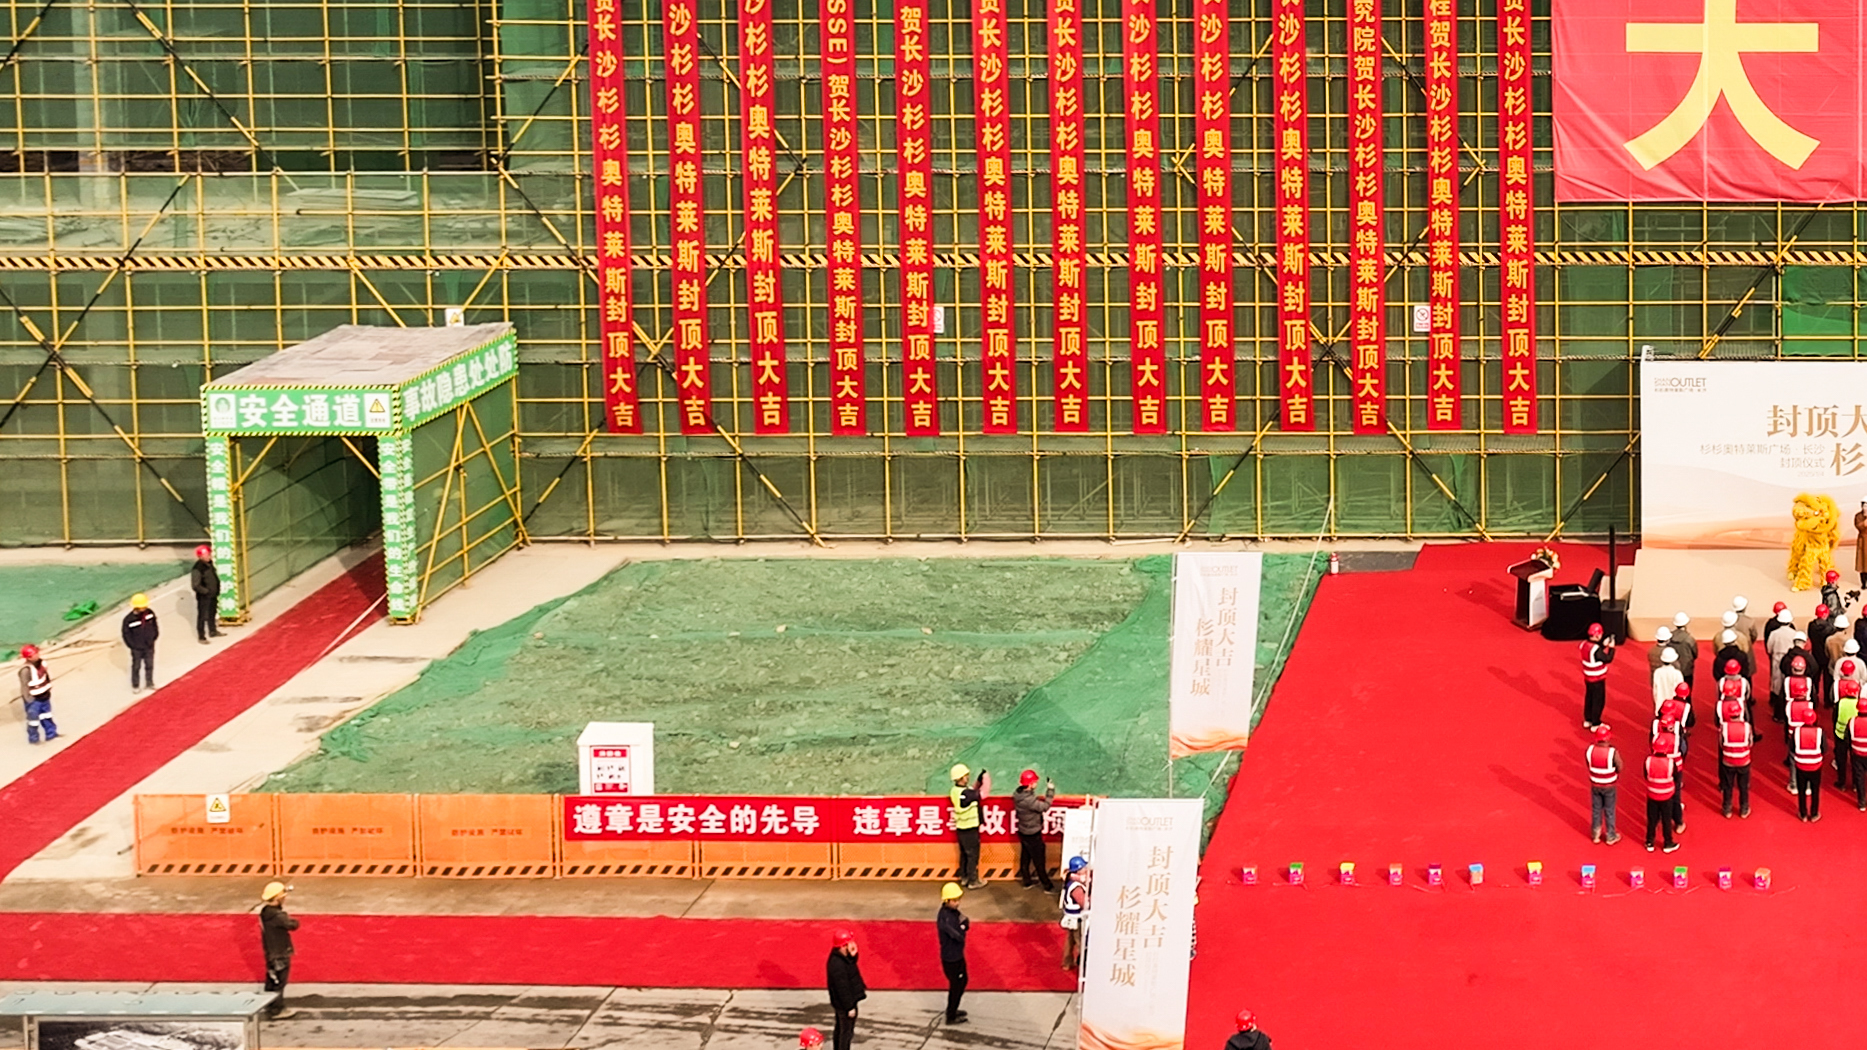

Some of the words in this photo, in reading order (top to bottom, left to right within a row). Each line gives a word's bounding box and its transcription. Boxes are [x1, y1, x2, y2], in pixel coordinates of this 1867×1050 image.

[827, 73, 859, 427] 贺长沙杉杉奥特莱斯封顶大吉
[900, 5, 933, 427] 贺长沙杉杉奥特莱斯封顶大吉
[239, 393, 363, 429] 安全通道
[402, 340, 513, 422] 事故隐患处处防
[1670, 377, 1706, 388] OUTLET
[1190, 619, 1214, 697] 杉耀星城
[1216, 587, 1239, 667] 封顶大吉
[573, 803, 820, 836] 遵章是安全的先导
[1110, 885, 1142, 987] 杉耀星城
[1143, 846, 1174, 949] 封顶大吉
